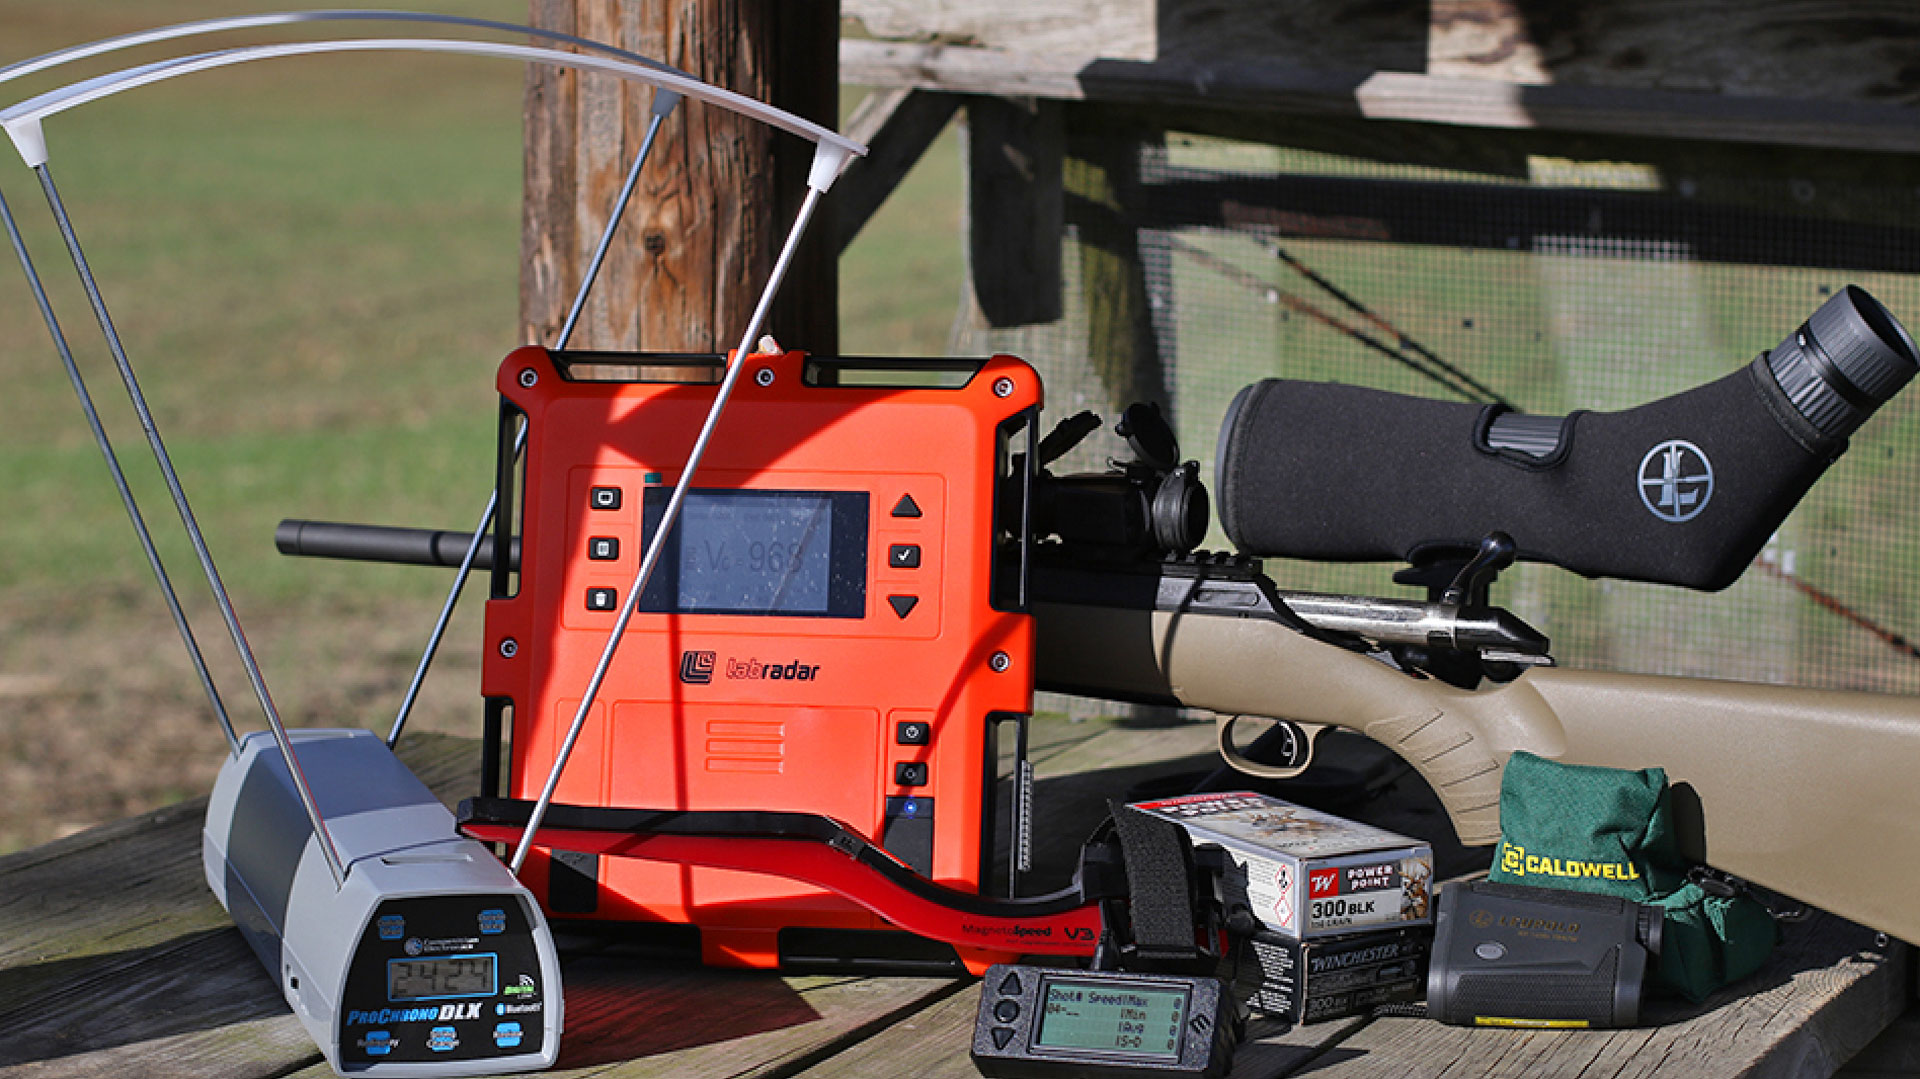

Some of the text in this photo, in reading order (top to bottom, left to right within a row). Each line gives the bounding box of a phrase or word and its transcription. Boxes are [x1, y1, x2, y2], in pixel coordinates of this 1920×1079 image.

[726, 657, 822, 682] labradar
[1347, 865, 1394, 880] POWER
[1525, 855, 1641, 881] CALDWELL
[1351, 876, 1390, 891] POINT
[1312, 899, 1375, 919] 300 BLK
[961, 924, 1096, 941] MagnetoSpeed V3
[1499, 914, 1582, 933] LEUPOLD
[1311, 943, 1400, 972] WINCHESTER
